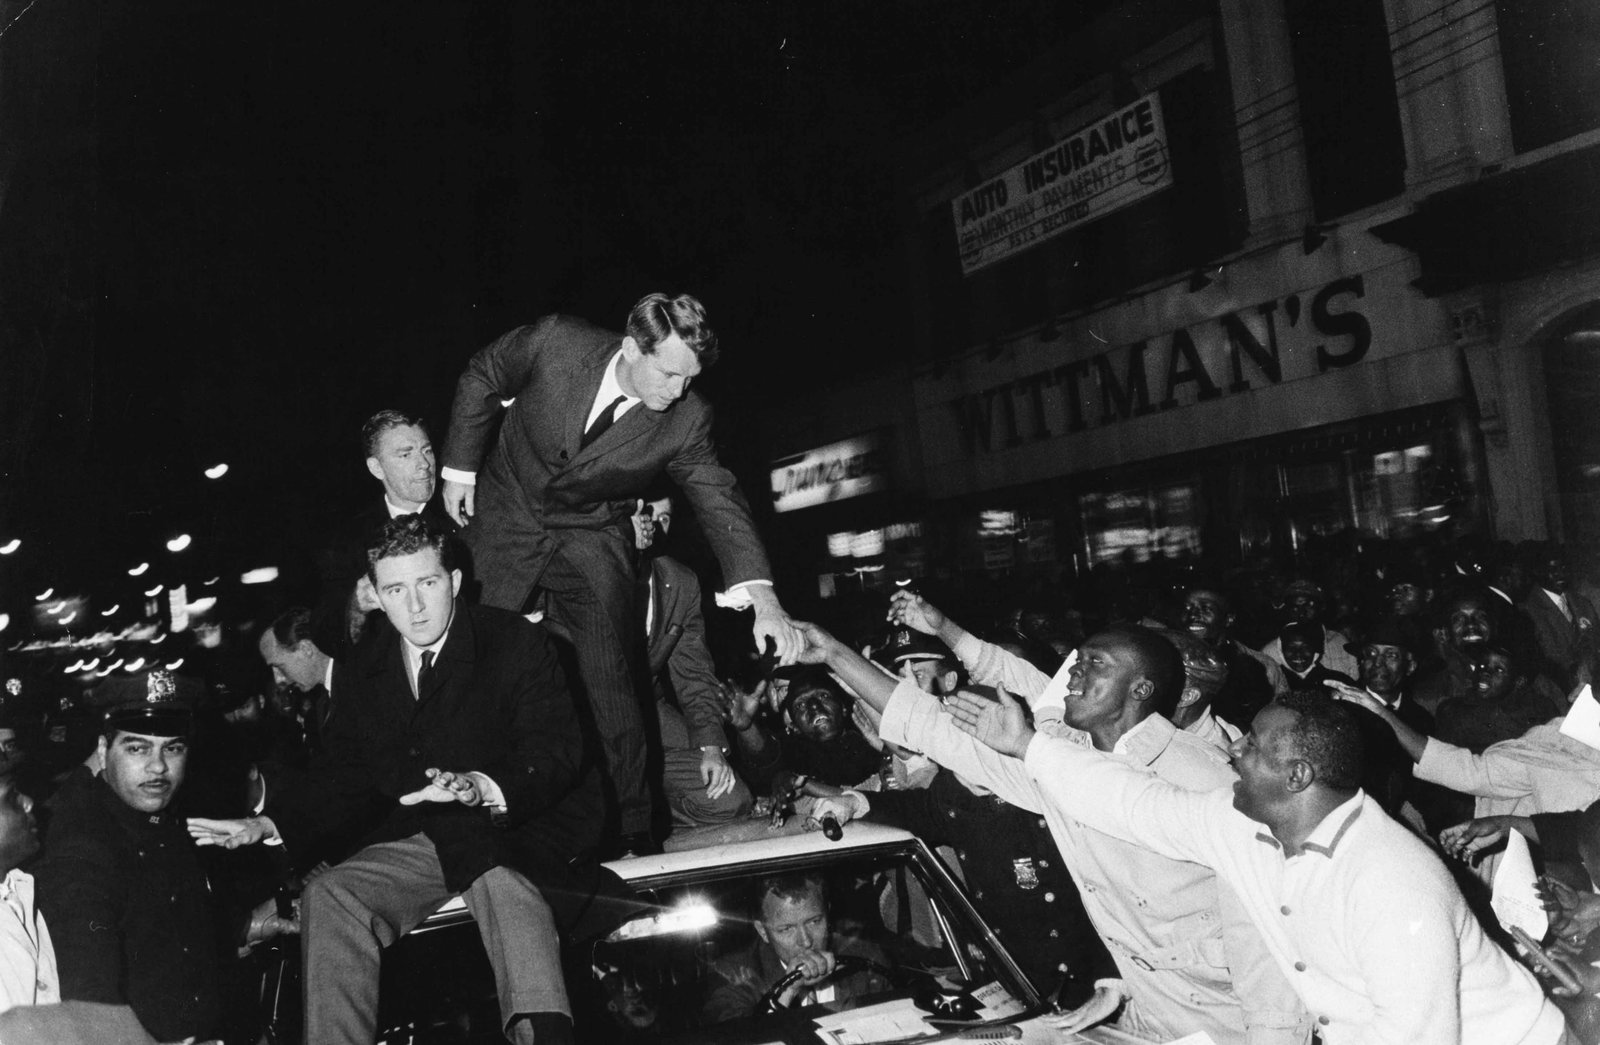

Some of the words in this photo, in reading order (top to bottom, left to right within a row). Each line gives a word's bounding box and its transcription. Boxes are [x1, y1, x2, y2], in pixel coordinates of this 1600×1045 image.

[961, 178, 1009, 227] AUTO
[1022, 101, 1154, 195] INSURANCE
[979, 201, 1036, 246] MONTHLY
[1042, 155, 1126, 211] PAYMENTS
[953, 275, 1372, 455] WITTMAN'S
